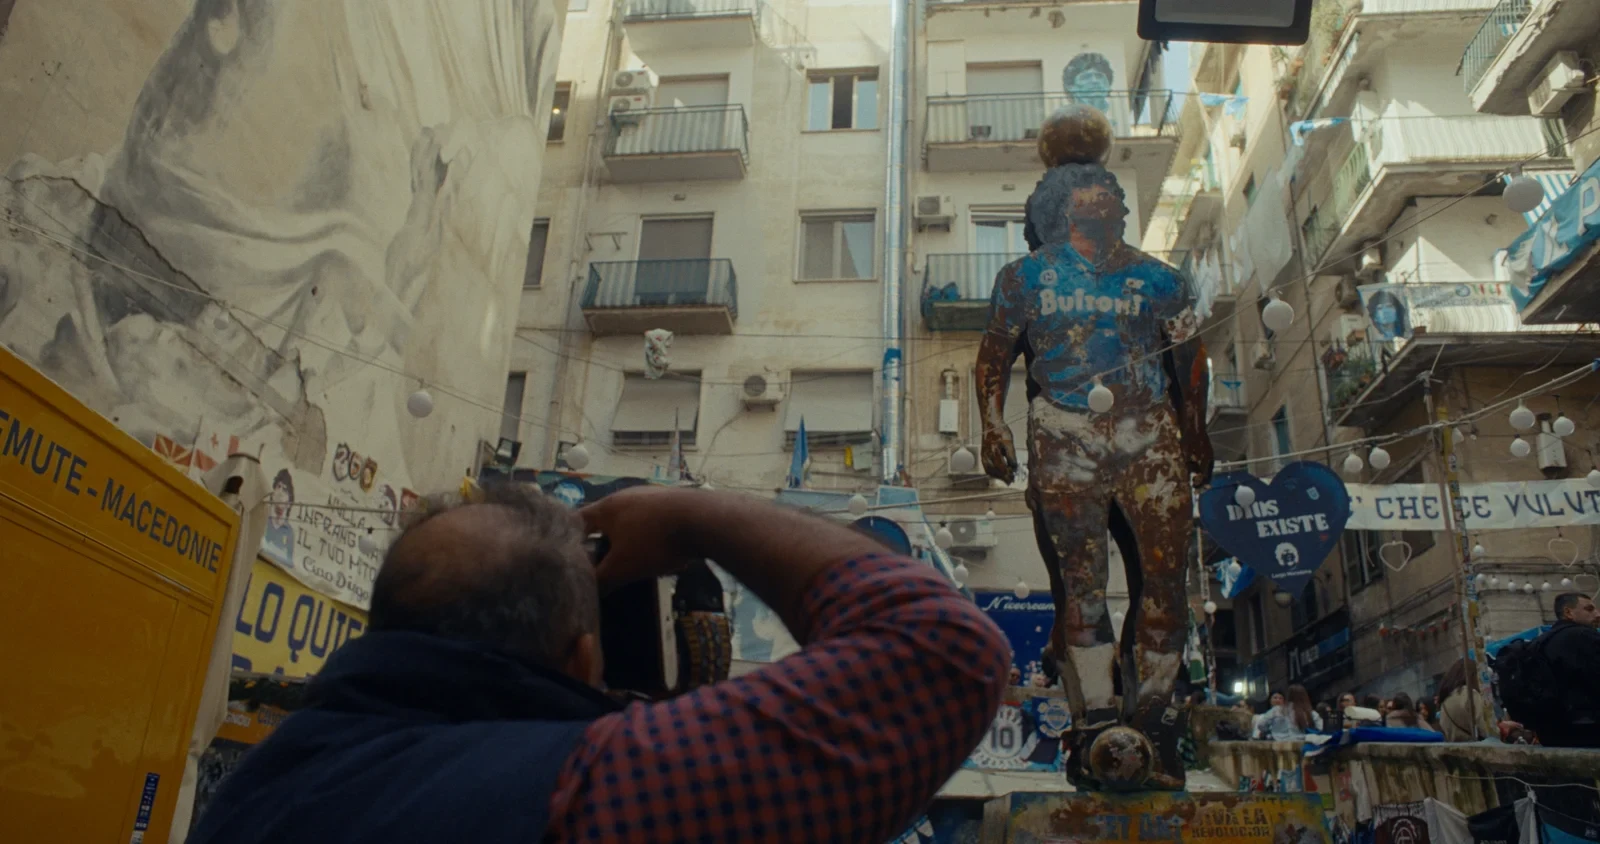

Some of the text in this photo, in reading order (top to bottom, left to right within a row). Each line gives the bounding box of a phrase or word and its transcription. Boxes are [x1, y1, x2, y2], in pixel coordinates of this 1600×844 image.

[1376, 496, 1439, 519] CHE
[1256, 513, 1330, 538] EXISTE
[296, 526, 313, 551] IL
